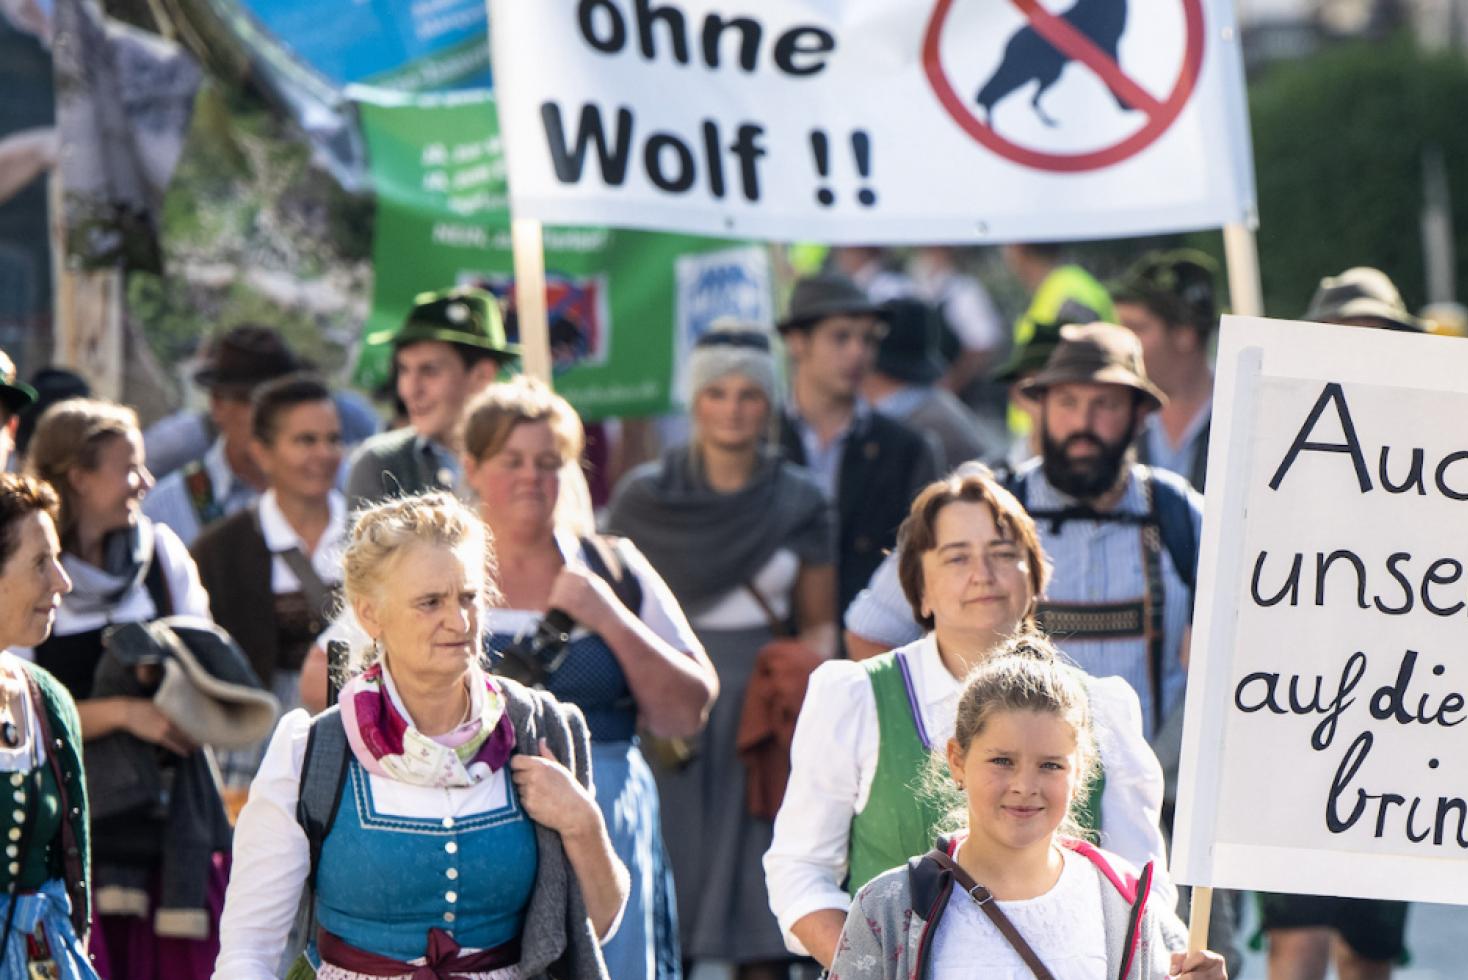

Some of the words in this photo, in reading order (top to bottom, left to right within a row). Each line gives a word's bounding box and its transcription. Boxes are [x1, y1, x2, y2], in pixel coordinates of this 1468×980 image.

[576, 0, 836, 77] ohne
[540, 101, 767, 203] Wolf
[809, 130, 877, 207] !!
[1234, 651, 1367, 751] auf
[1369, 648, 1467, 727] die
